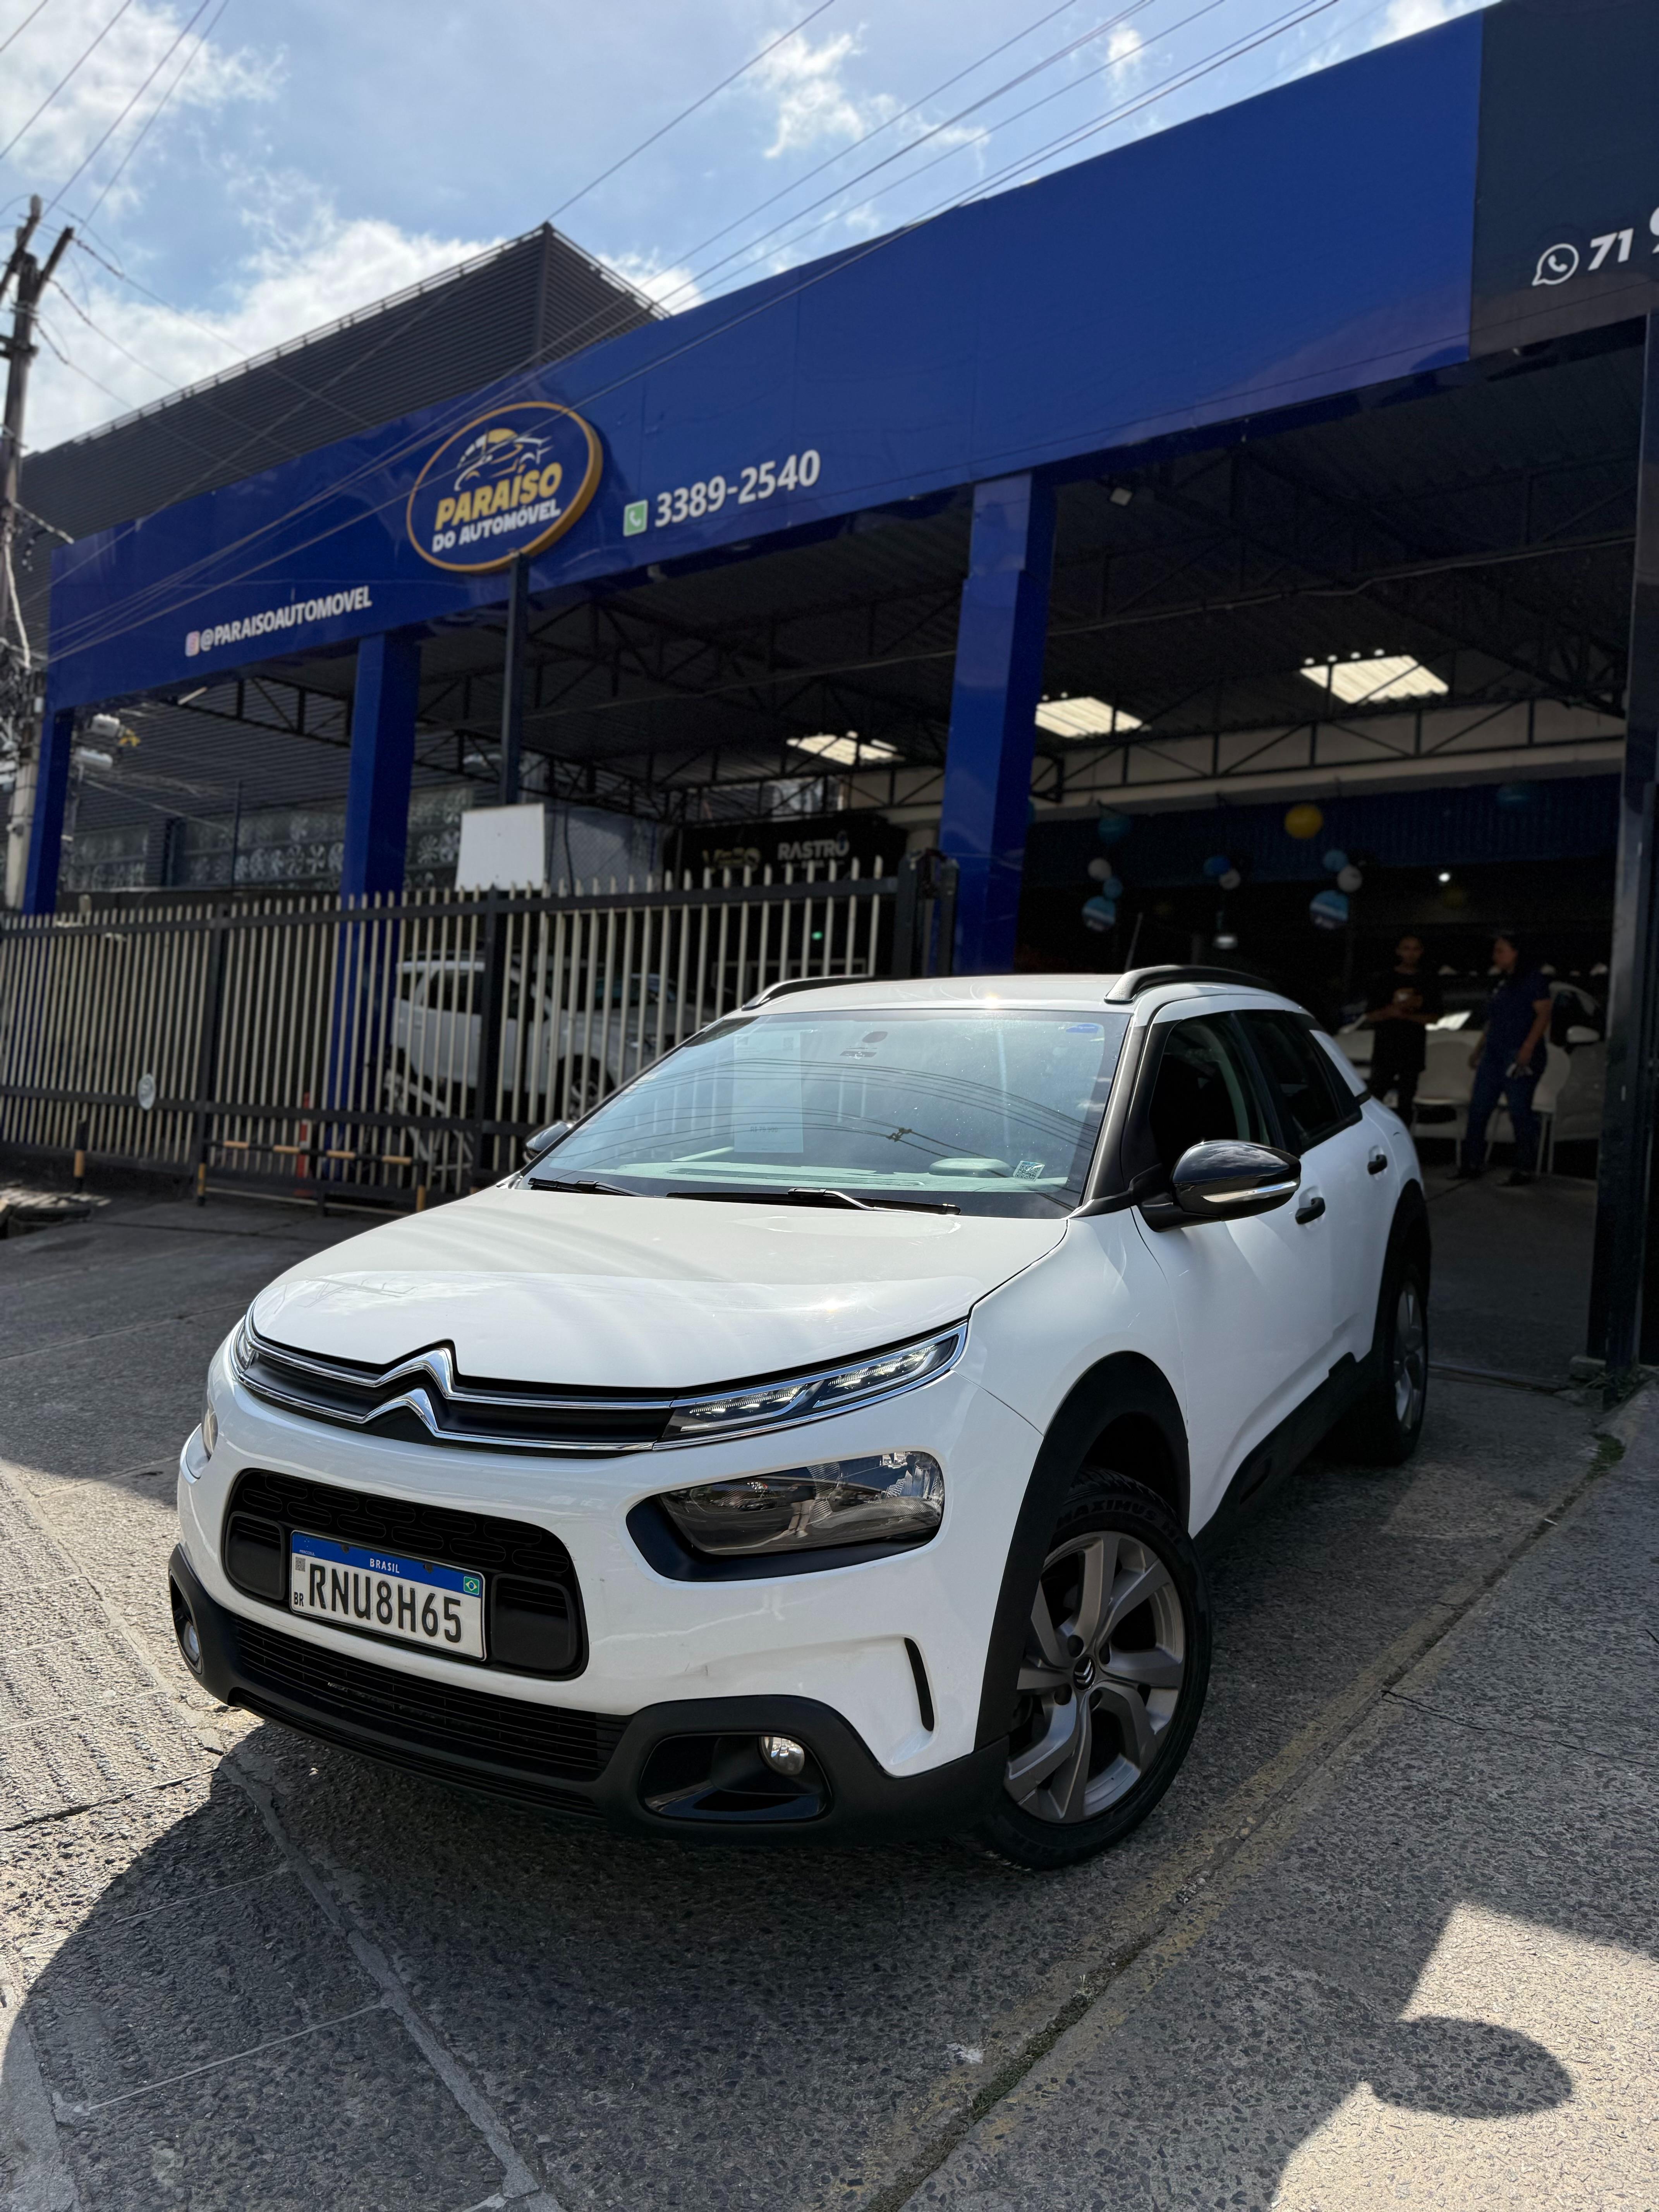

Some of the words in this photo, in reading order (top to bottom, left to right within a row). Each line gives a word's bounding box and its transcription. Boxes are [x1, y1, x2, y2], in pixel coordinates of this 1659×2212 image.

[1588, 228, 1634, 271] 71
[435, 462, 562, 531] PARAÍSO
[655, 449, 821, 527] 3389-2540
[432, 531, 456, 553] DO
[459, 498, 561, 545] AUTOMÓVEL
[200, 585, 373, 651] @PARAISOAUTOMOVEL
[777, 833, 850, 860] RASTRO
[369, 1558, 400, 1574] BRASIL
[294, 1591, 304, 1607] BR
[309, 1563, 462, 1643] RNU8H65
